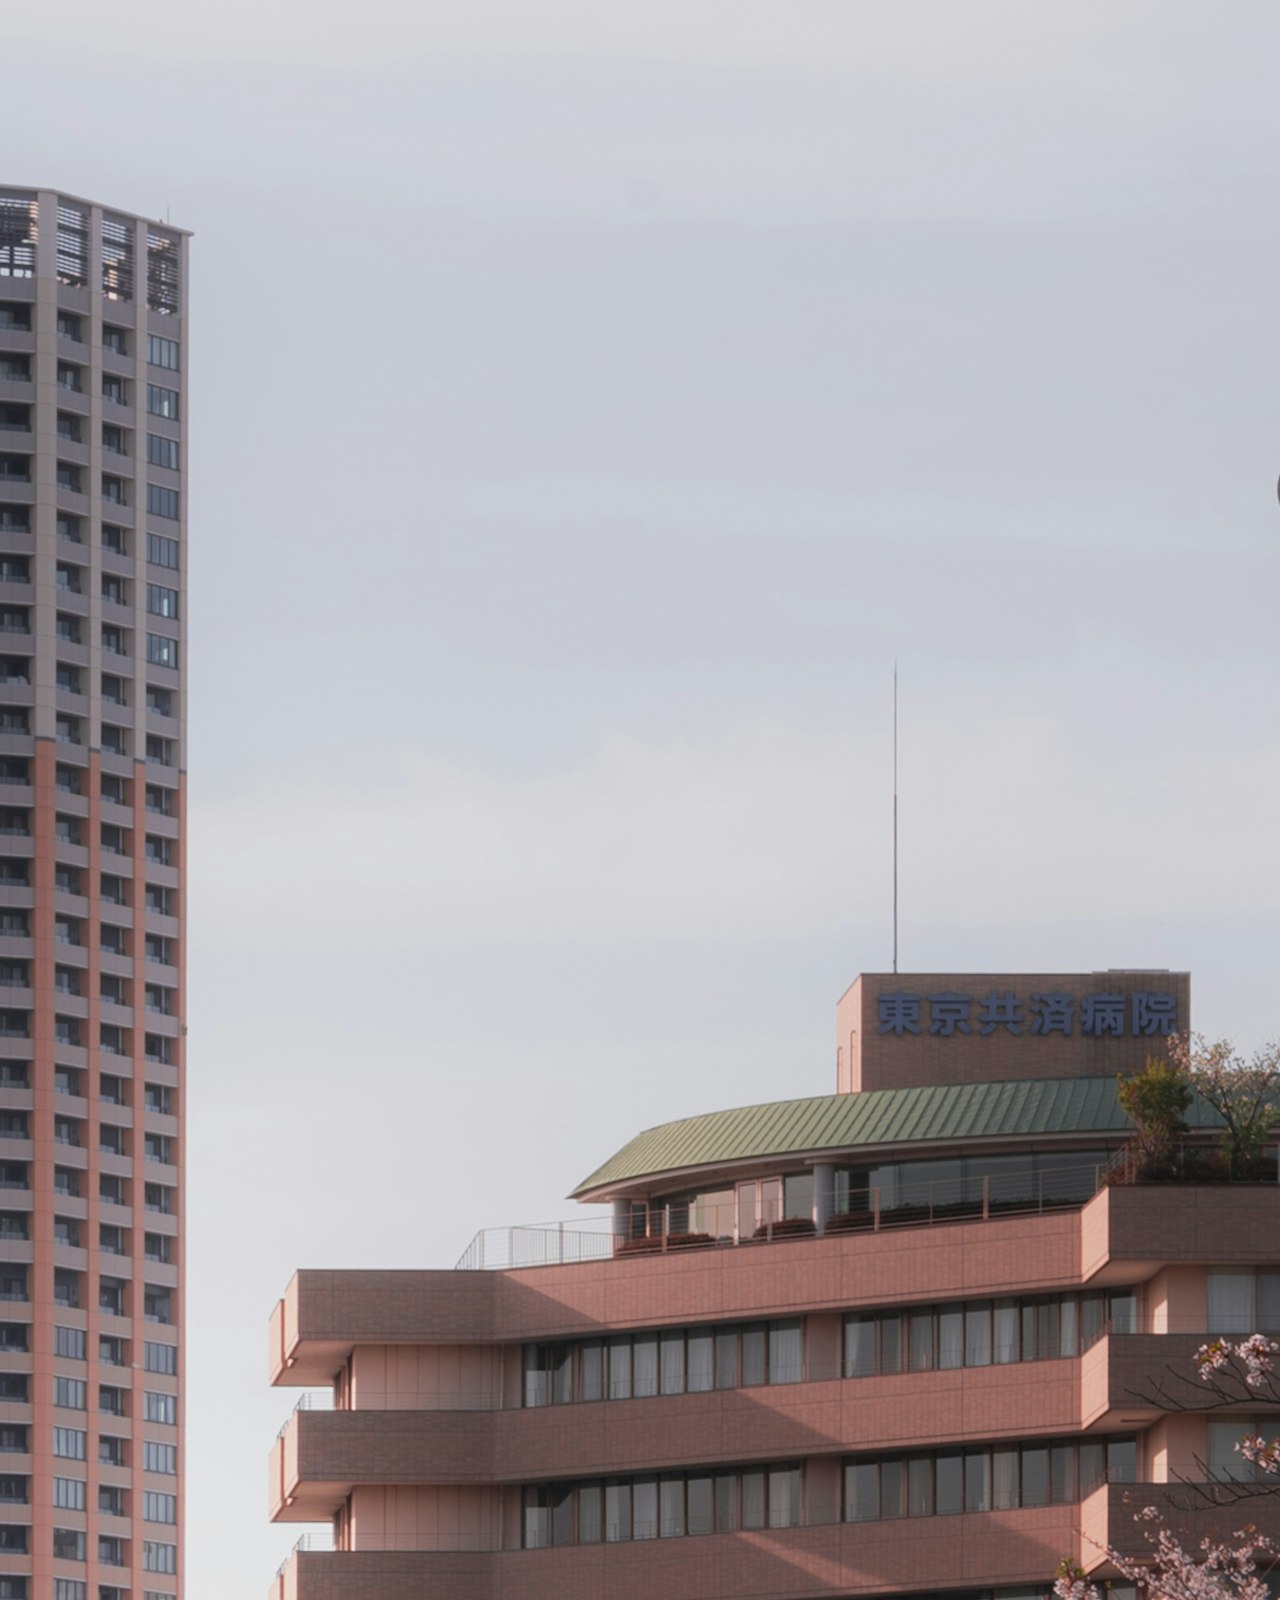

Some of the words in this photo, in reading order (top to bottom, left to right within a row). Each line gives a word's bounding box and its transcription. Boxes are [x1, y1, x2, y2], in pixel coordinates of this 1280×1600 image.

[876, 991, 1178, 1037] 東京共済病院
